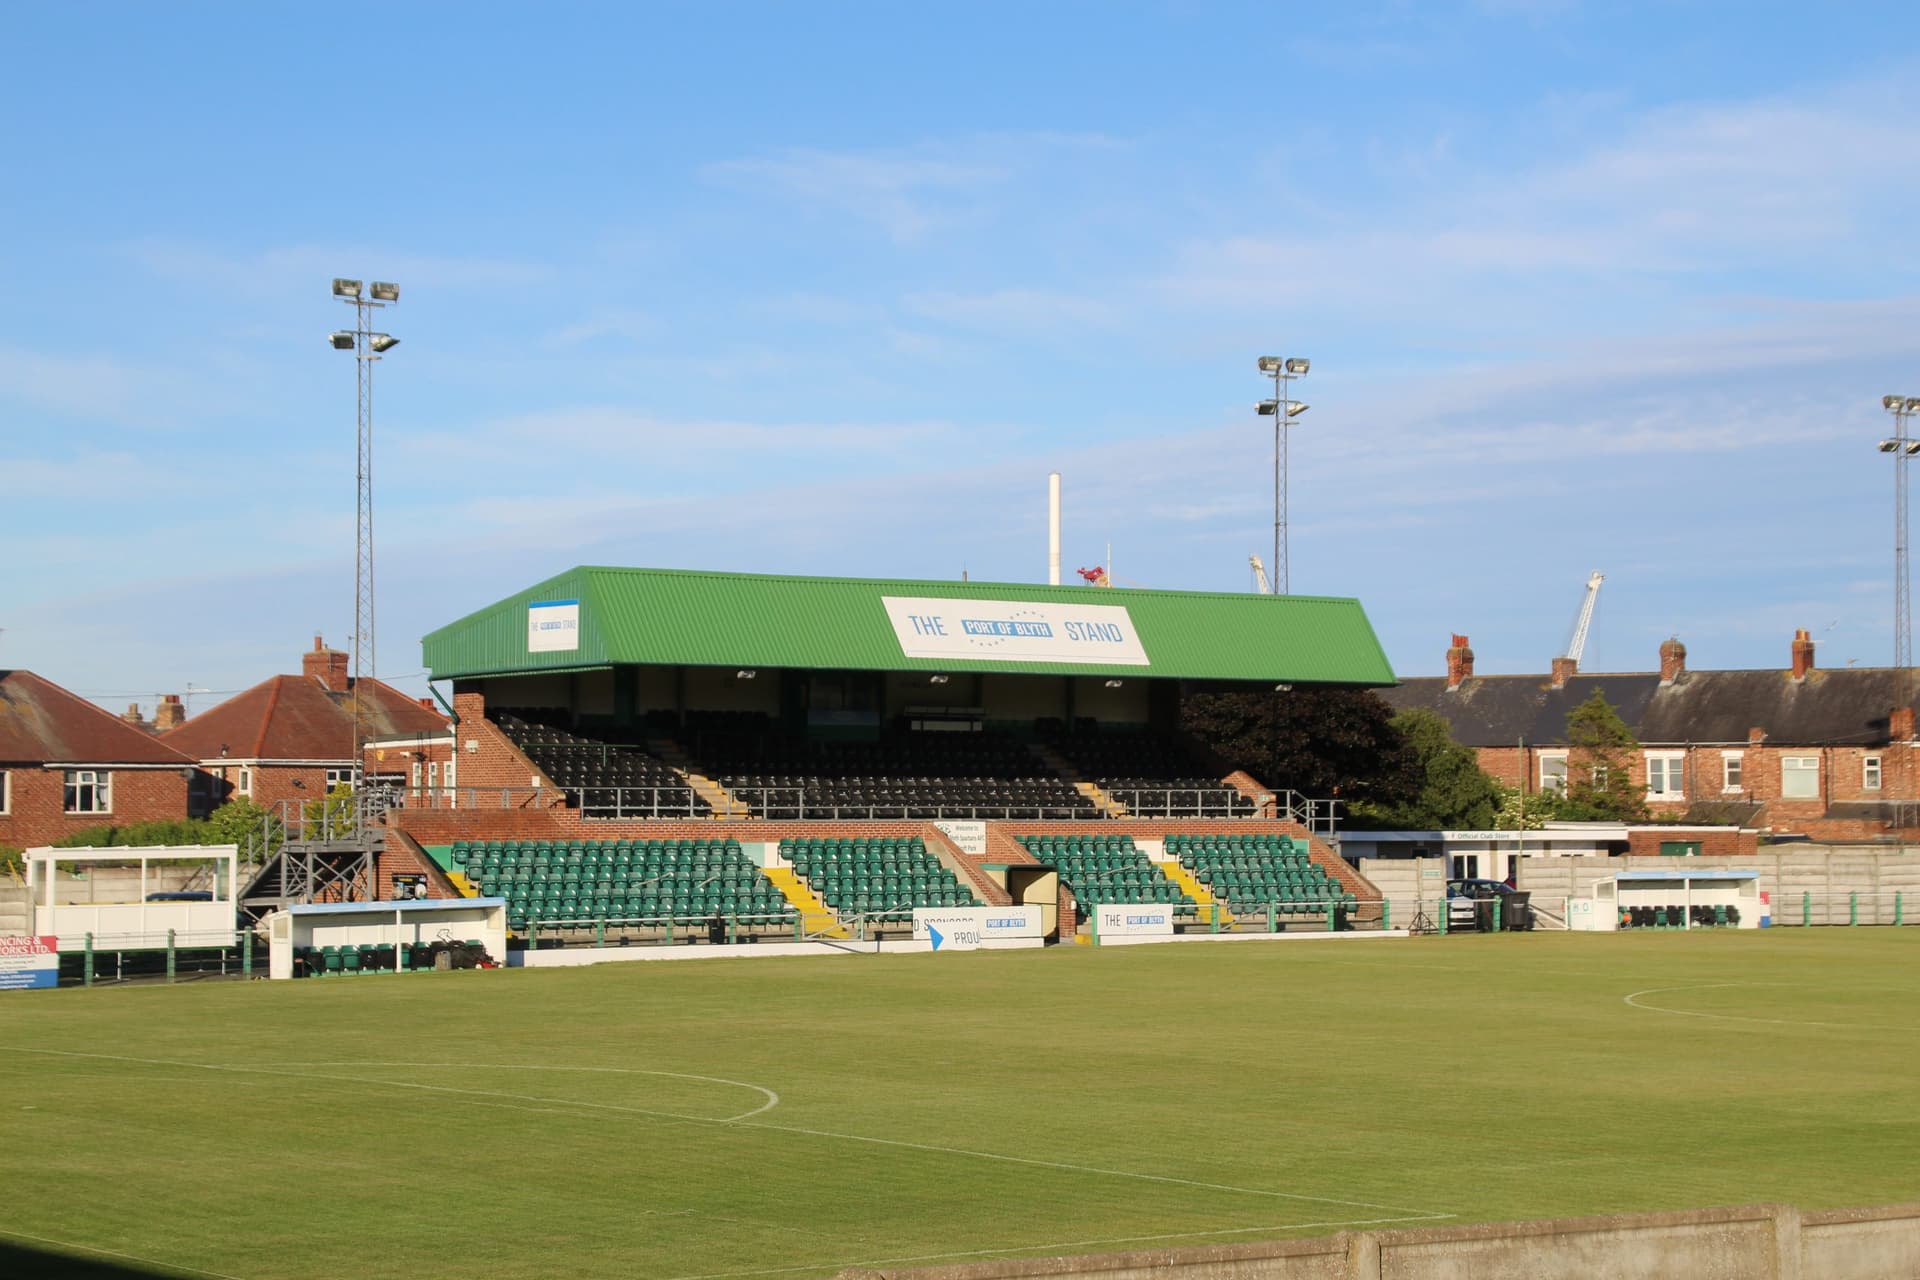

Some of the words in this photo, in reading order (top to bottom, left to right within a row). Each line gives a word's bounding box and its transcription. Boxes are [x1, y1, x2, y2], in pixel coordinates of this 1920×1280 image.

[908, 615, 948, 636] THE
[966, 621, 996, 634] PORT
[997, 622, 1013, 635] OF
[1014, 622, 1050, 637] BLYTH
[1064, 621, 1123, 642] STAND
[1105, 914, 1121, 927] THE
[33, 936, 41, 945] &
[0, 945, 29, 955] ORKS
